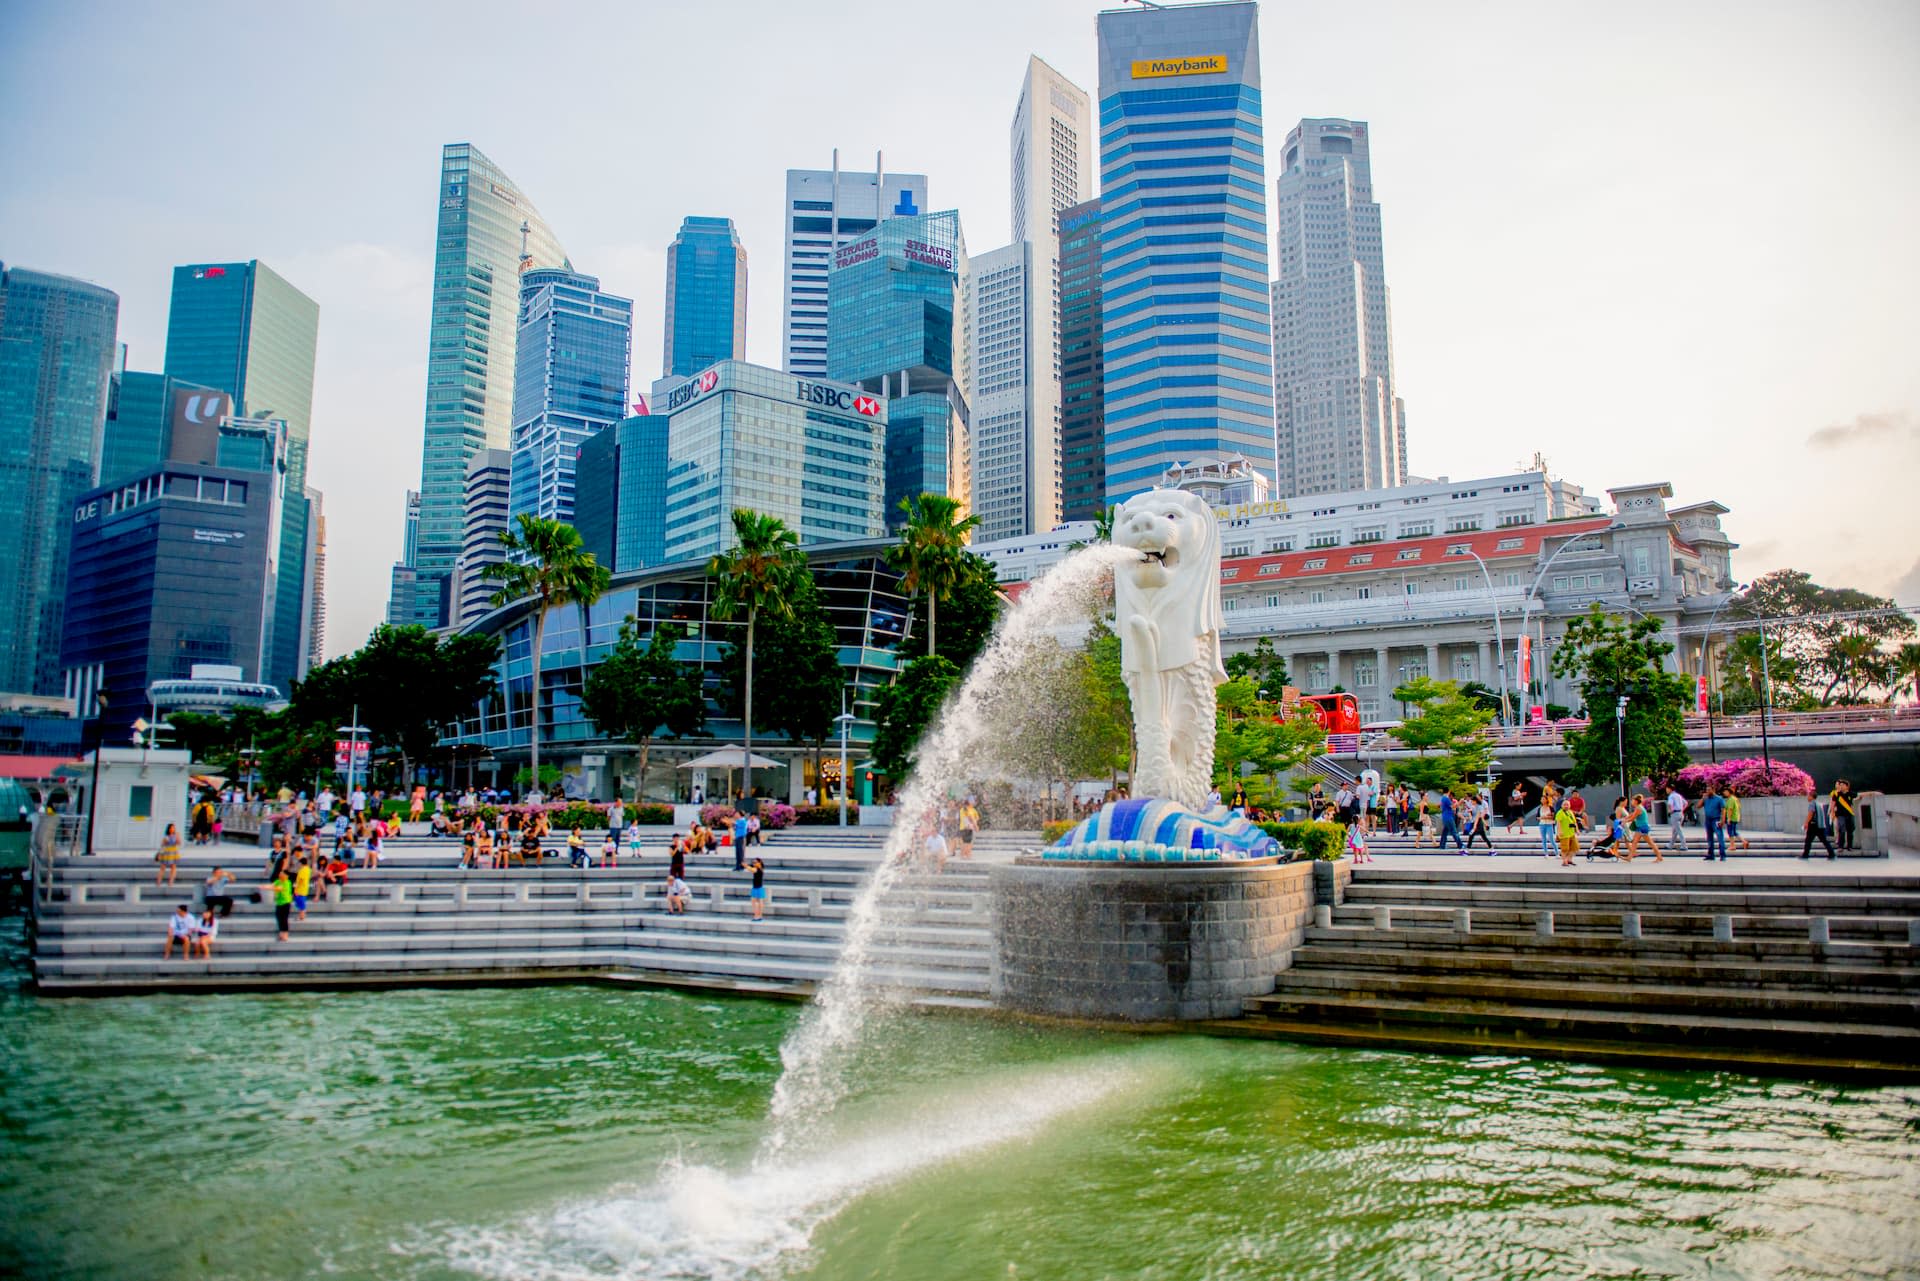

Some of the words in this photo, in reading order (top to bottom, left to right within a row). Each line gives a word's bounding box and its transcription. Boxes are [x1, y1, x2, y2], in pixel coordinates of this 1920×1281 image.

[1151, 58, 1218, 74] Maybank
[836, 238, 877, 258] STRAITS
[906, 239, 952, 259] STRAITS
[835, 248, 879, 269] TRADING
[904, 249, 952, 270] TRADING
[667, 377, 701, 411] HSBC
[797, 381, 851, 410] HSBC
[1235, 501, 1289, 518] HOTEL
